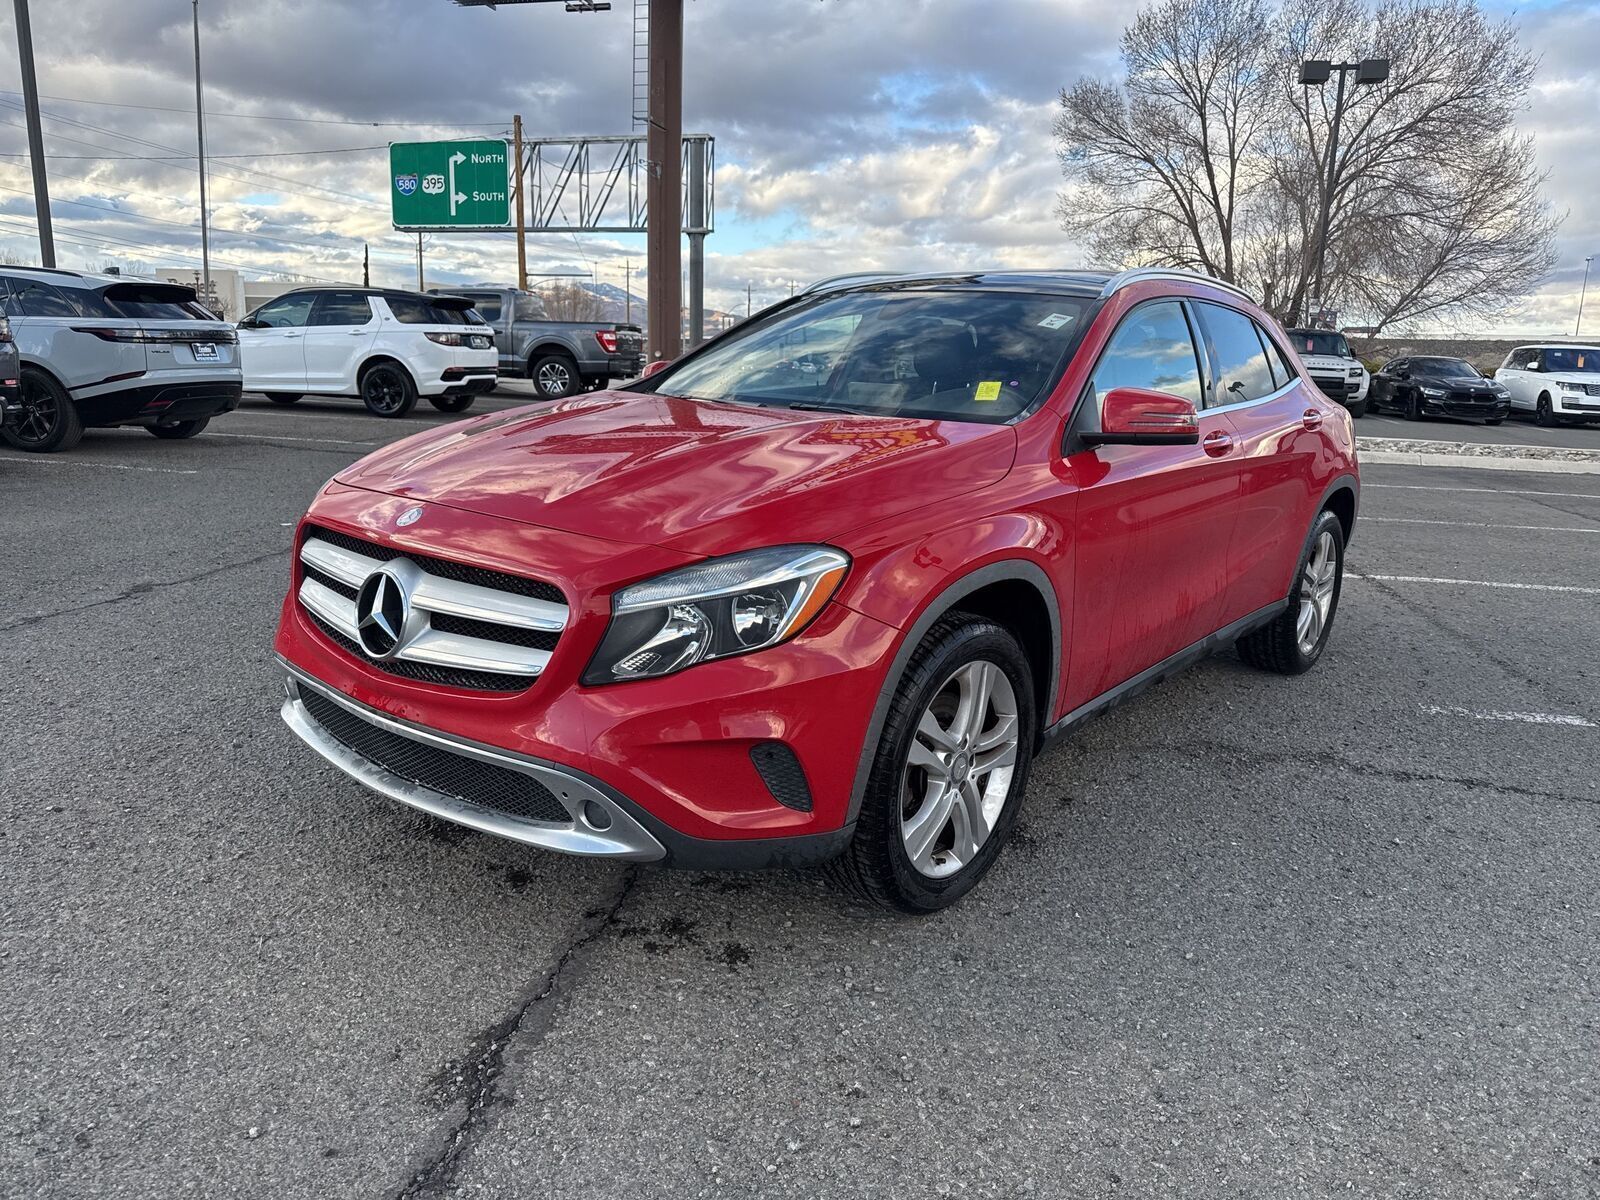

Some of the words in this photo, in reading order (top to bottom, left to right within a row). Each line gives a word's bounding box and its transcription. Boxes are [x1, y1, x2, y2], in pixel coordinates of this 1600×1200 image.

[471, 153, 504, 164] NORTH
[398, 180, 416, 190] 580
[423, 178, 444, 190] 395
[472, 191, 505, 202] SOUTH
